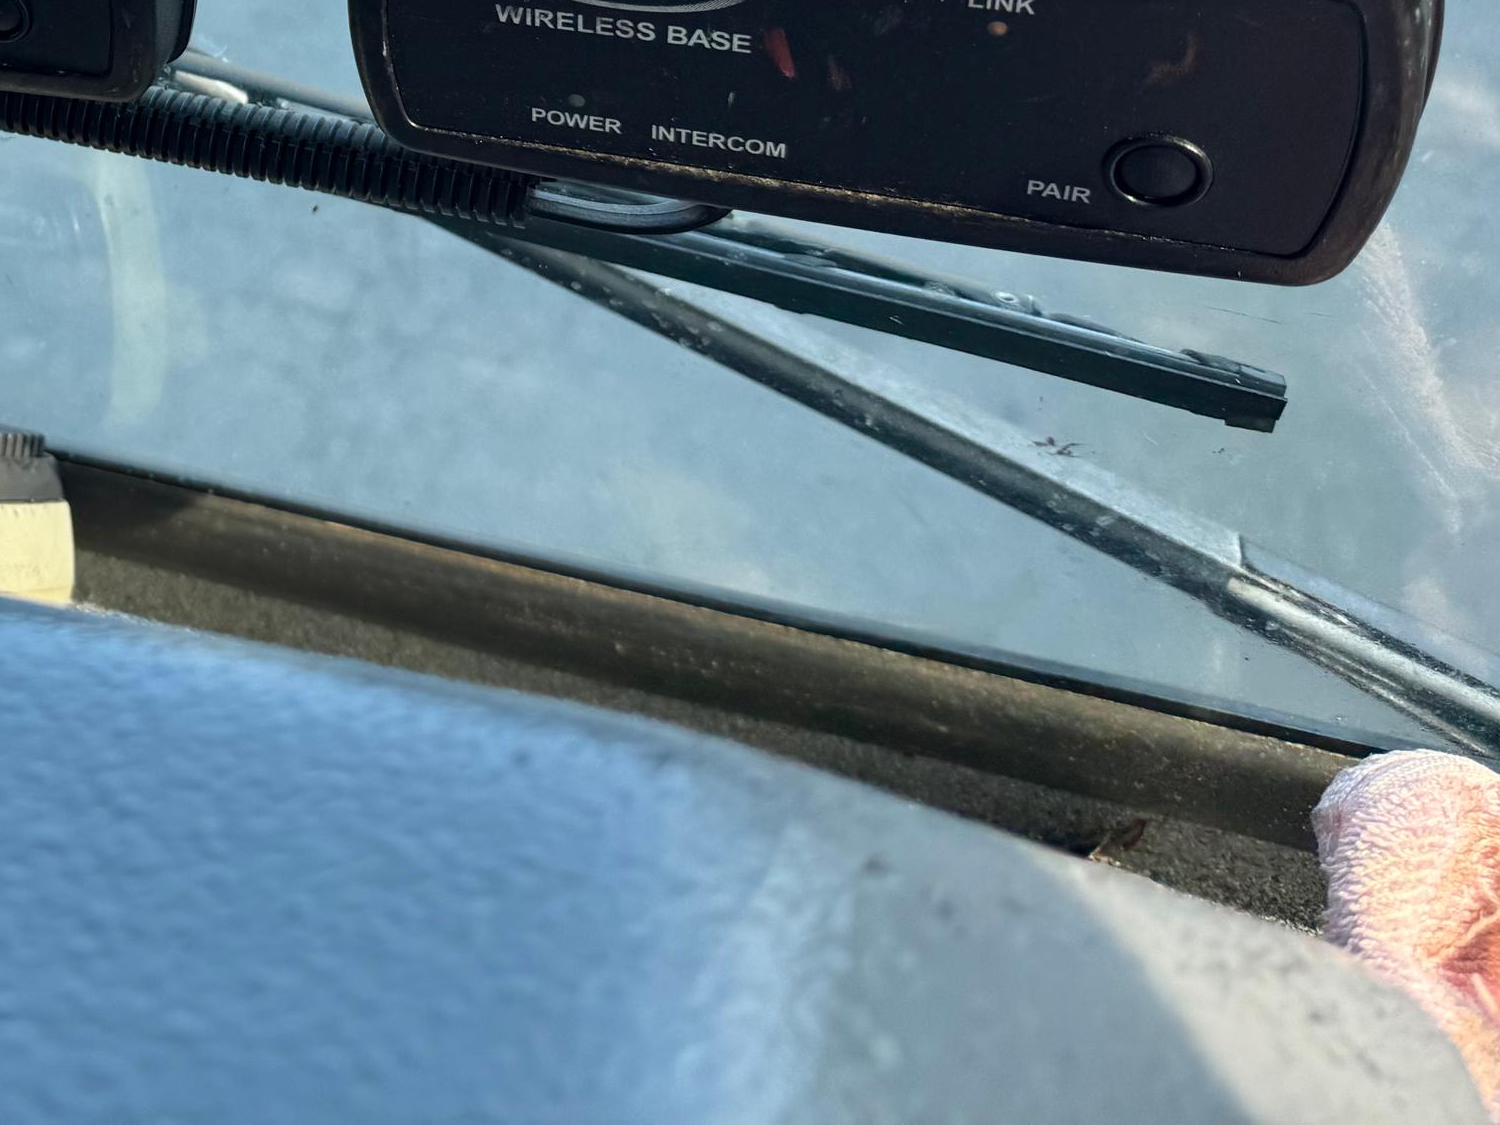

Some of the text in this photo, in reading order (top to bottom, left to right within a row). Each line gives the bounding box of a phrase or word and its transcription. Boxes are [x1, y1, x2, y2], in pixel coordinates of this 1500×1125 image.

[495, 3, 752, 53] WIRELESS BASE
[531, 107, 787, 159] POWER INTERCOM
[1026, 179, 1091, 204] PAIR
